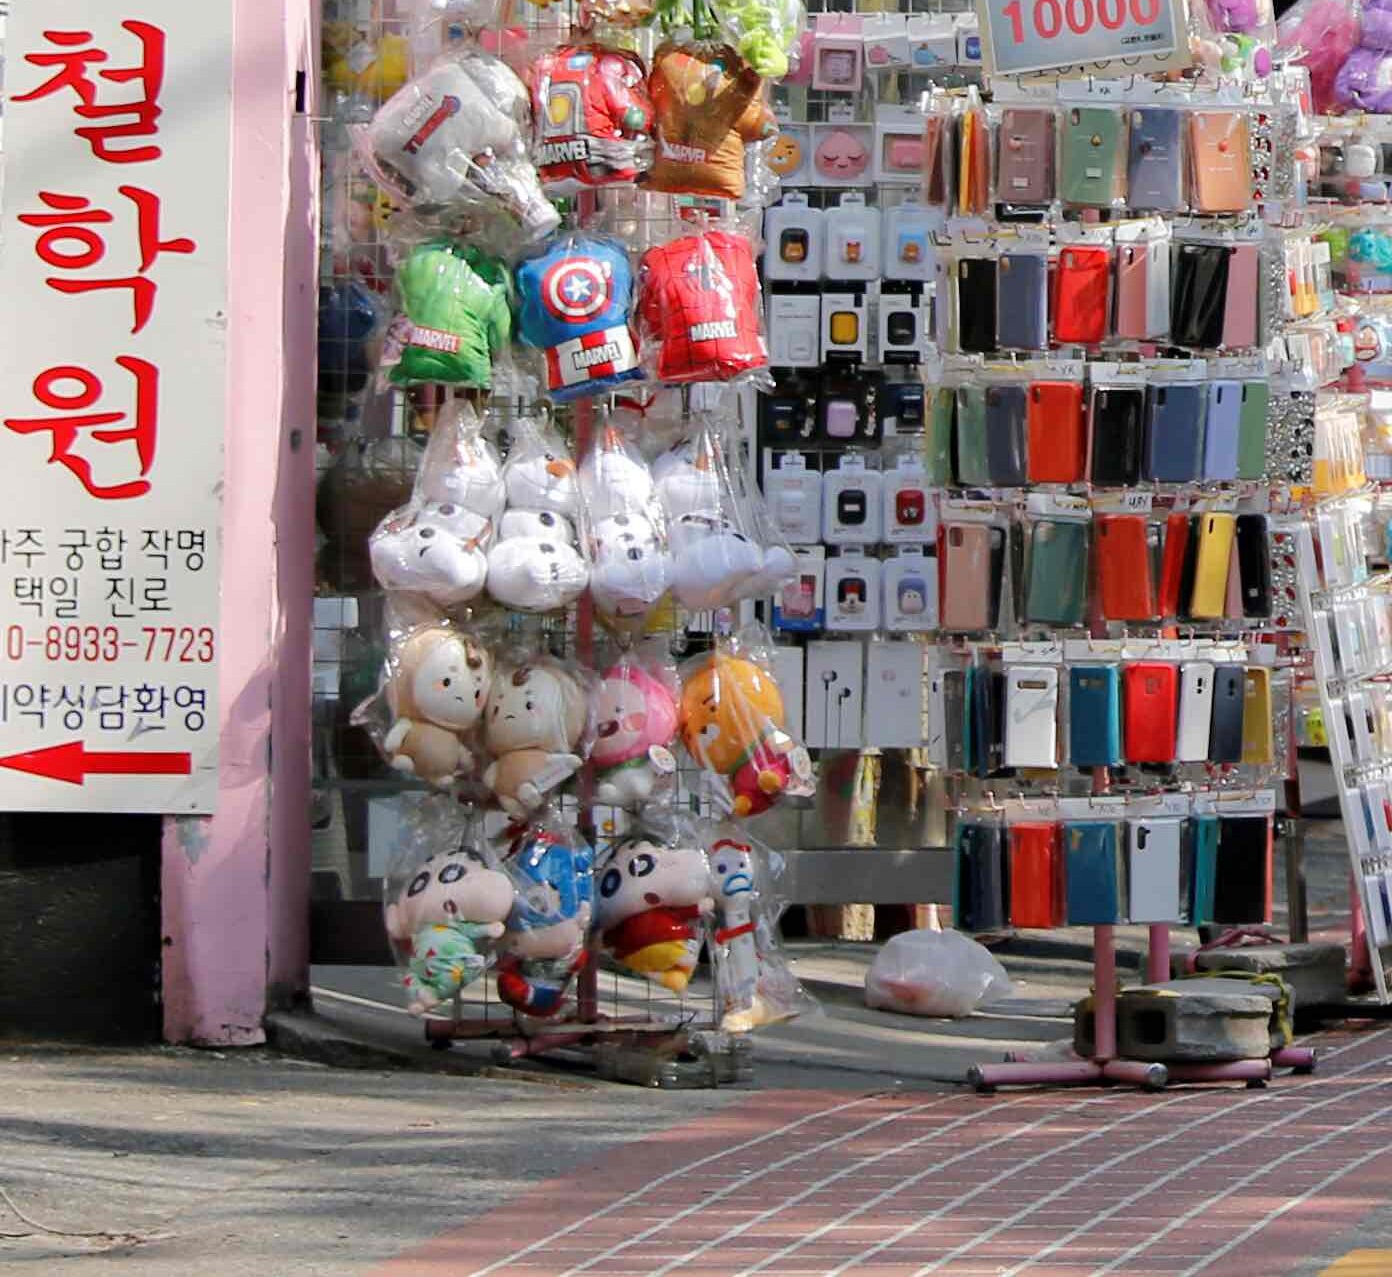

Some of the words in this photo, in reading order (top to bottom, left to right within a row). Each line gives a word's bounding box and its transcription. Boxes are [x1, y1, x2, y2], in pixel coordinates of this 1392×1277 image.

[3, 20, 197, 500] 철학원
[411, 326, 459, 351] MARVEL
[690, 321, 737, 342] MARVEL
[574, 341, 621, 369] MARVEL
[58, 526, 128, 571] 궁합
[141, 529, 206, 571] 작명
[14, 577, 79, 618] 택일
[105, 577, 173, 618] 진로
